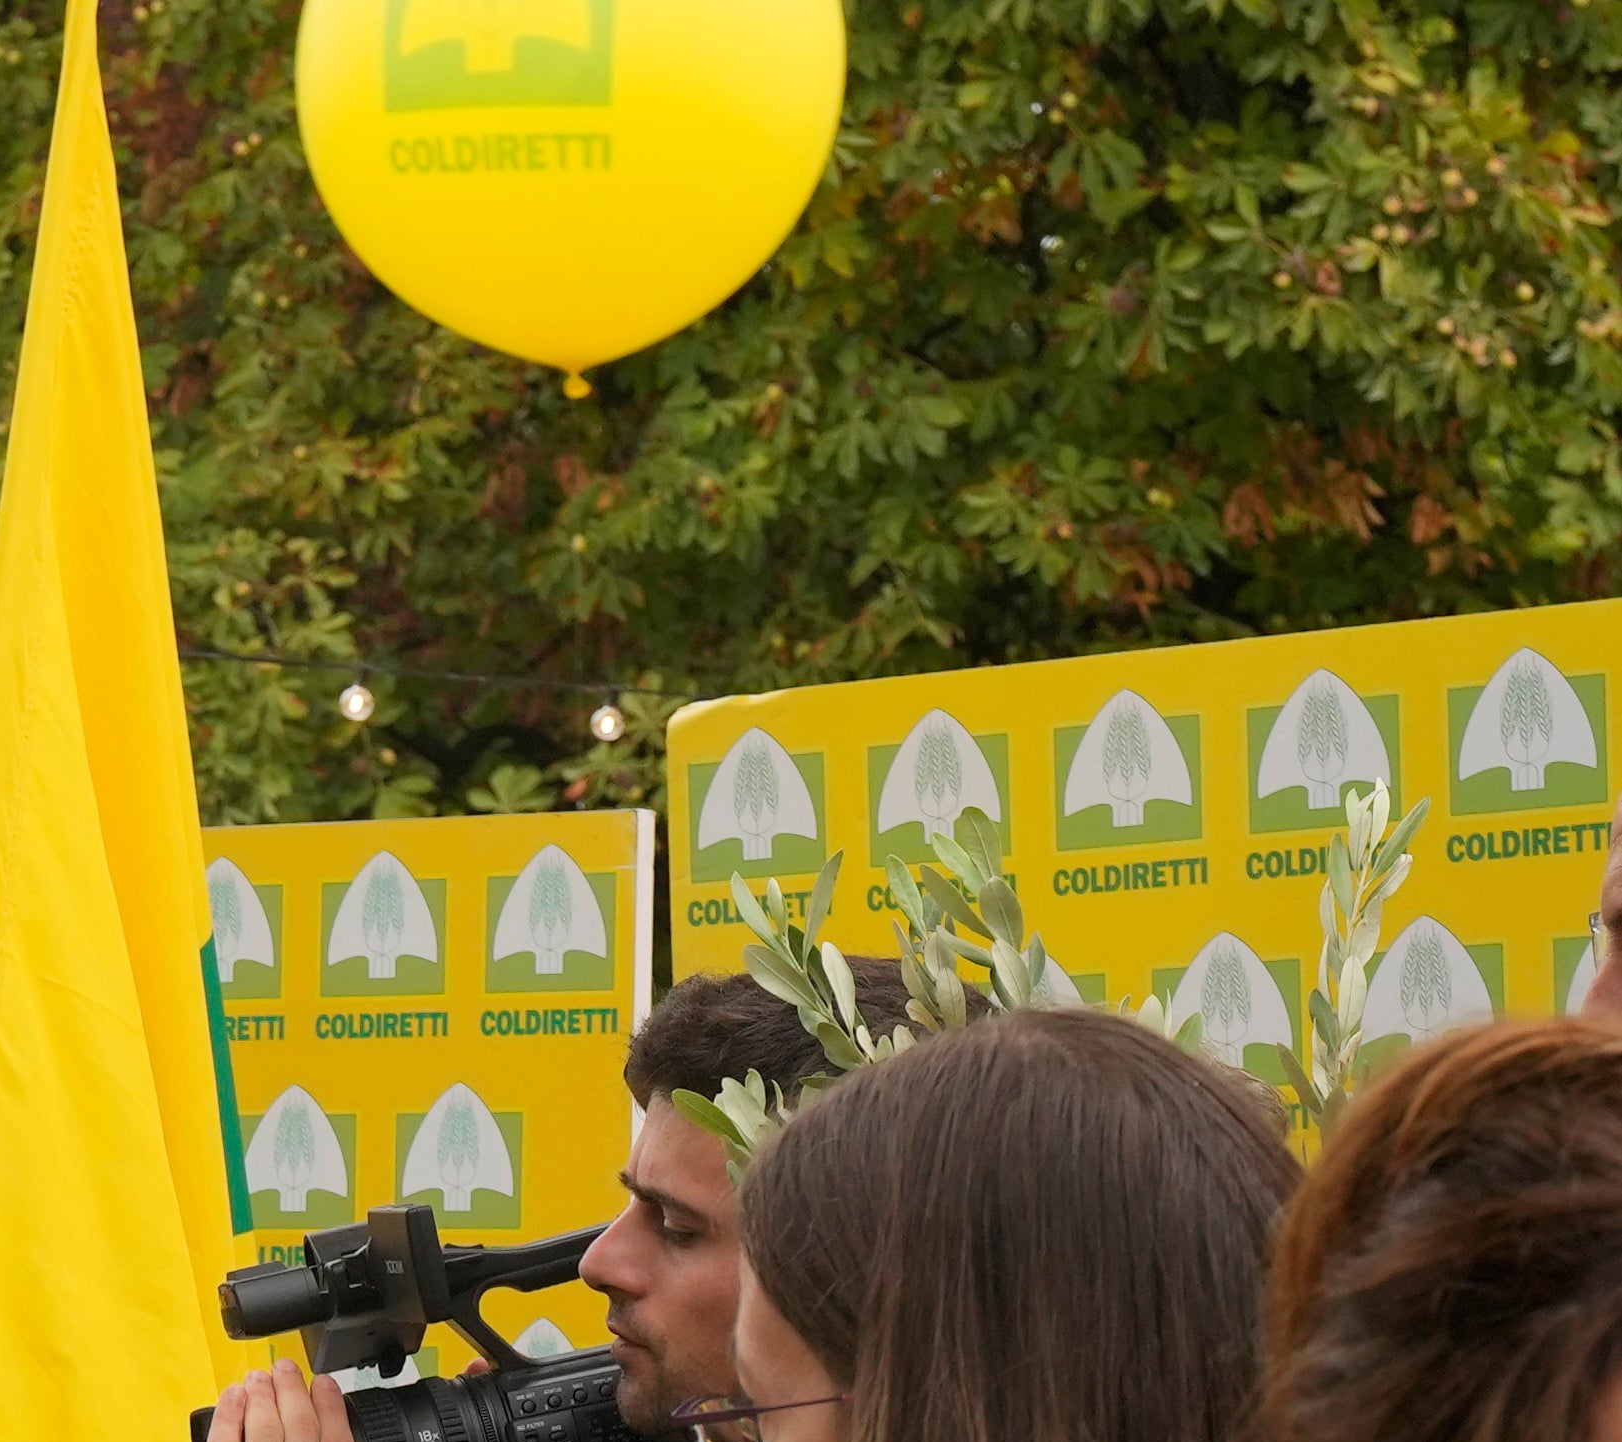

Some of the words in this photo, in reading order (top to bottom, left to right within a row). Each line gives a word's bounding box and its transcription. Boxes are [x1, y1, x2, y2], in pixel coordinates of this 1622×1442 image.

[390, 133, 612, 173] COLDIRETTI
[1451, 824, 1605, 861] COLDIRETTI
[1053, 857, 1208, 897] COLDIRETTI
[319, 1013, 446, 1038] COLDIRETTI
[483, 1009, 616, 1034] COLDIRETTI
